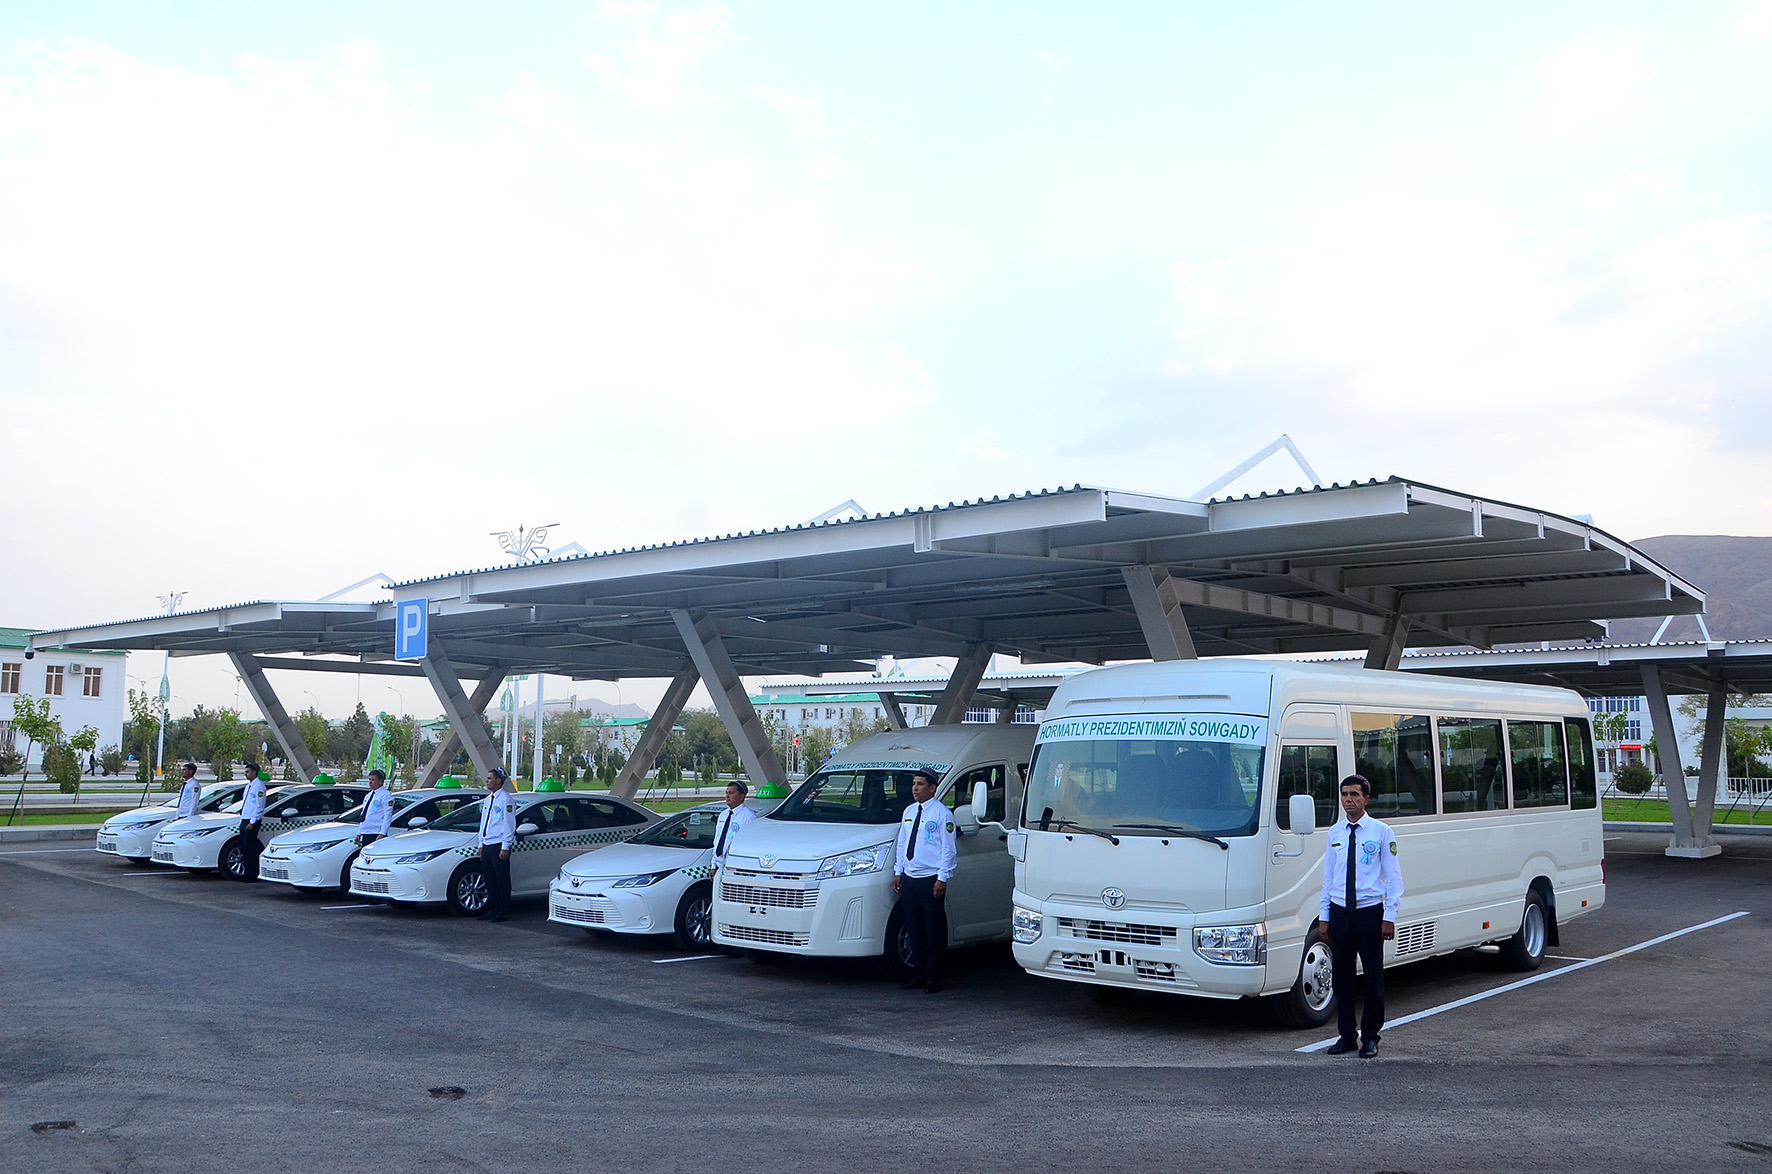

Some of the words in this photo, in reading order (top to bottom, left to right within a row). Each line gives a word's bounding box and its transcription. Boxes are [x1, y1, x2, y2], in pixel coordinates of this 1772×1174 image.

[402, 605, 422, 653] P
[1039, 722, 1088, 740] HORMATLY
[1189, 721, 1260, 740] SOWGADY
